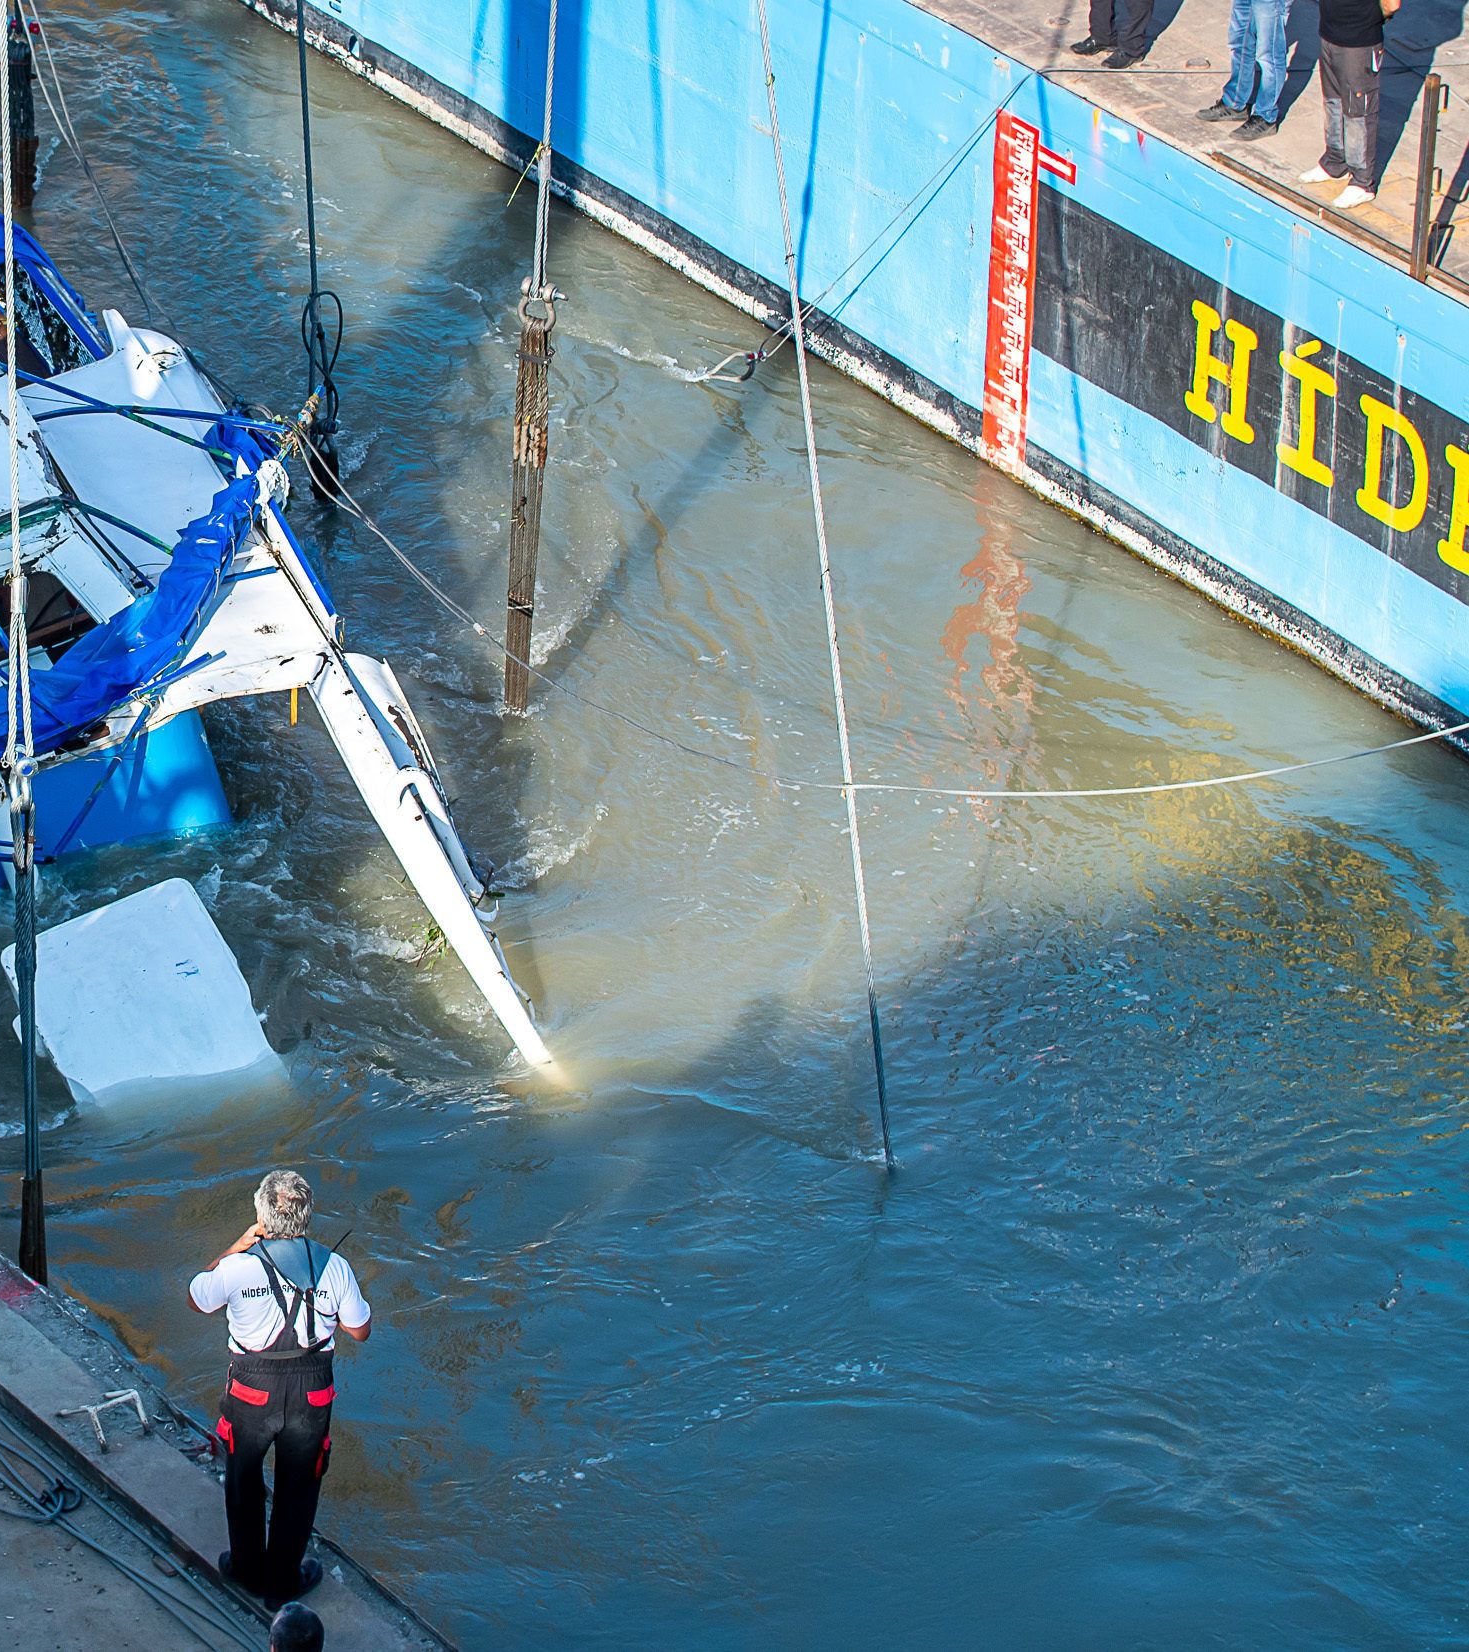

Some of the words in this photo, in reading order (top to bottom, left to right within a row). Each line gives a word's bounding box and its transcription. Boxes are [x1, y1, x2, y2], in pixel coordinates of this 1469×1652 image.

[1019, 167, 1033, 186] 23
[1019, 200, 1031, 220] 21
[1018, 233, 1030, 253] 19
[1015, 299, 1027, 319] 15
[1014, 332, 1025, 351] 13
[241, 1284, 275, 1299] HÍDÉPÍT
